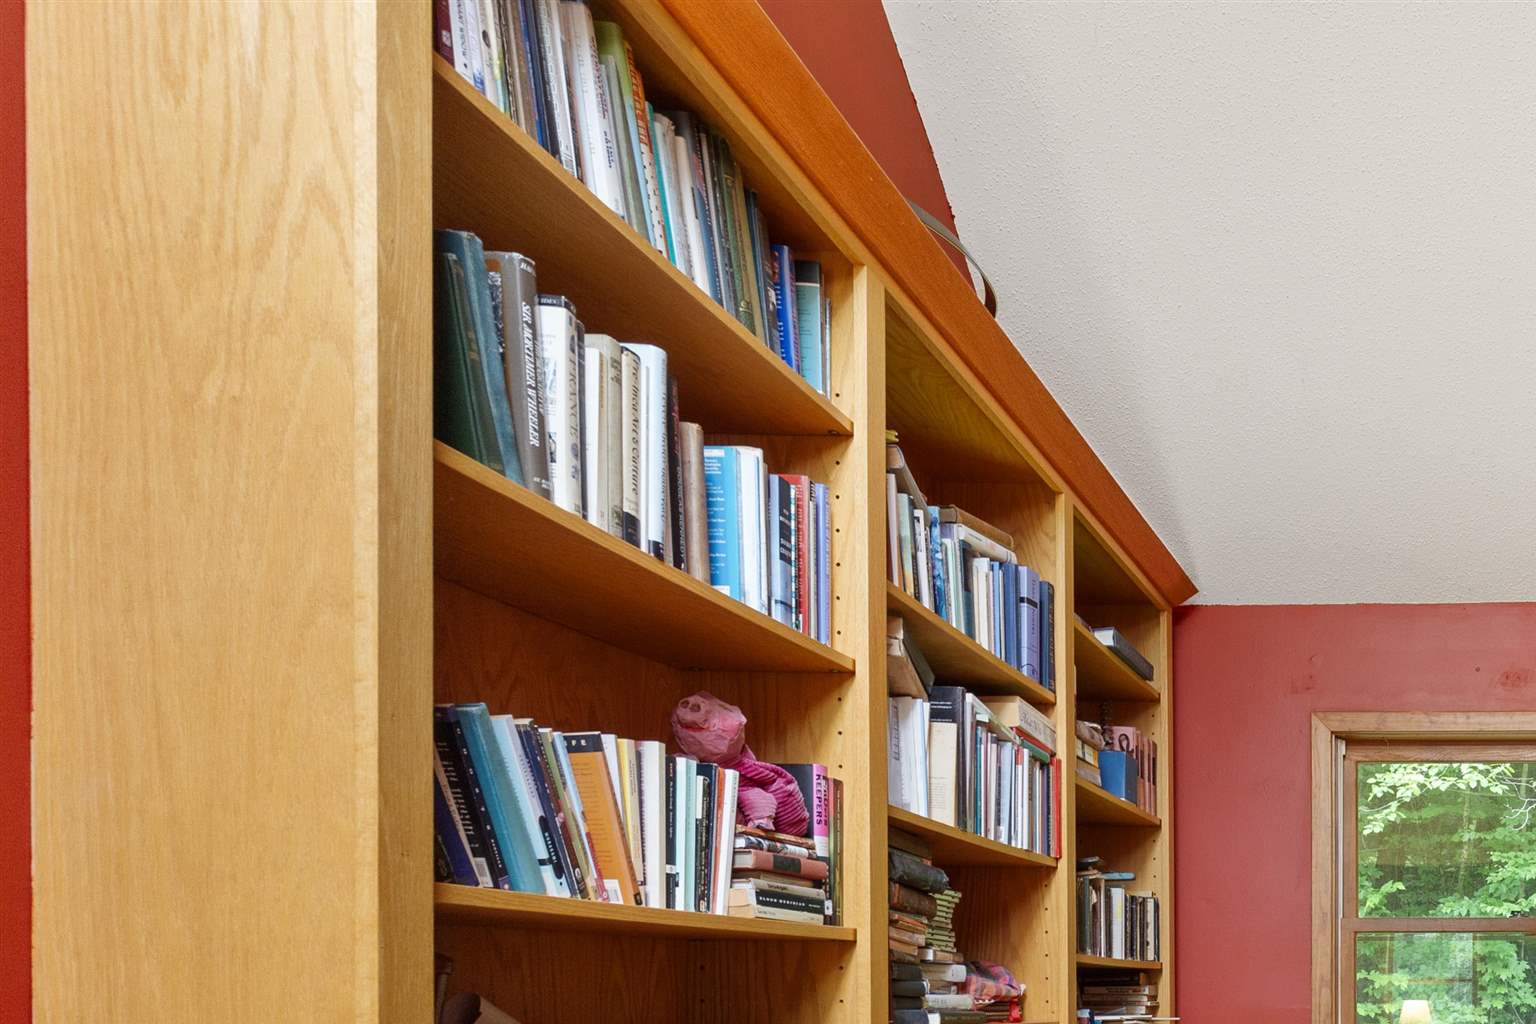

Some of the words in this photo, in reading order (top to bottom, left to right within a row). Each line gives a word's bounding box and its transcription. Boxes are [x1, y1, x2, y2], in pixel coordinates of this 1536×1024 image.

[521, 302, 533, 323] SIR
[522, 323, 536, 387] MORTIMER
[568, 357, 579, 438] FRANCE
[632, 357, 640, 414] Pre-Inca
[527, 388, 540, 448] WHEELER
[631, 446, 640, 496] Culture
[815, 774, 823, 825] KEEPERS
